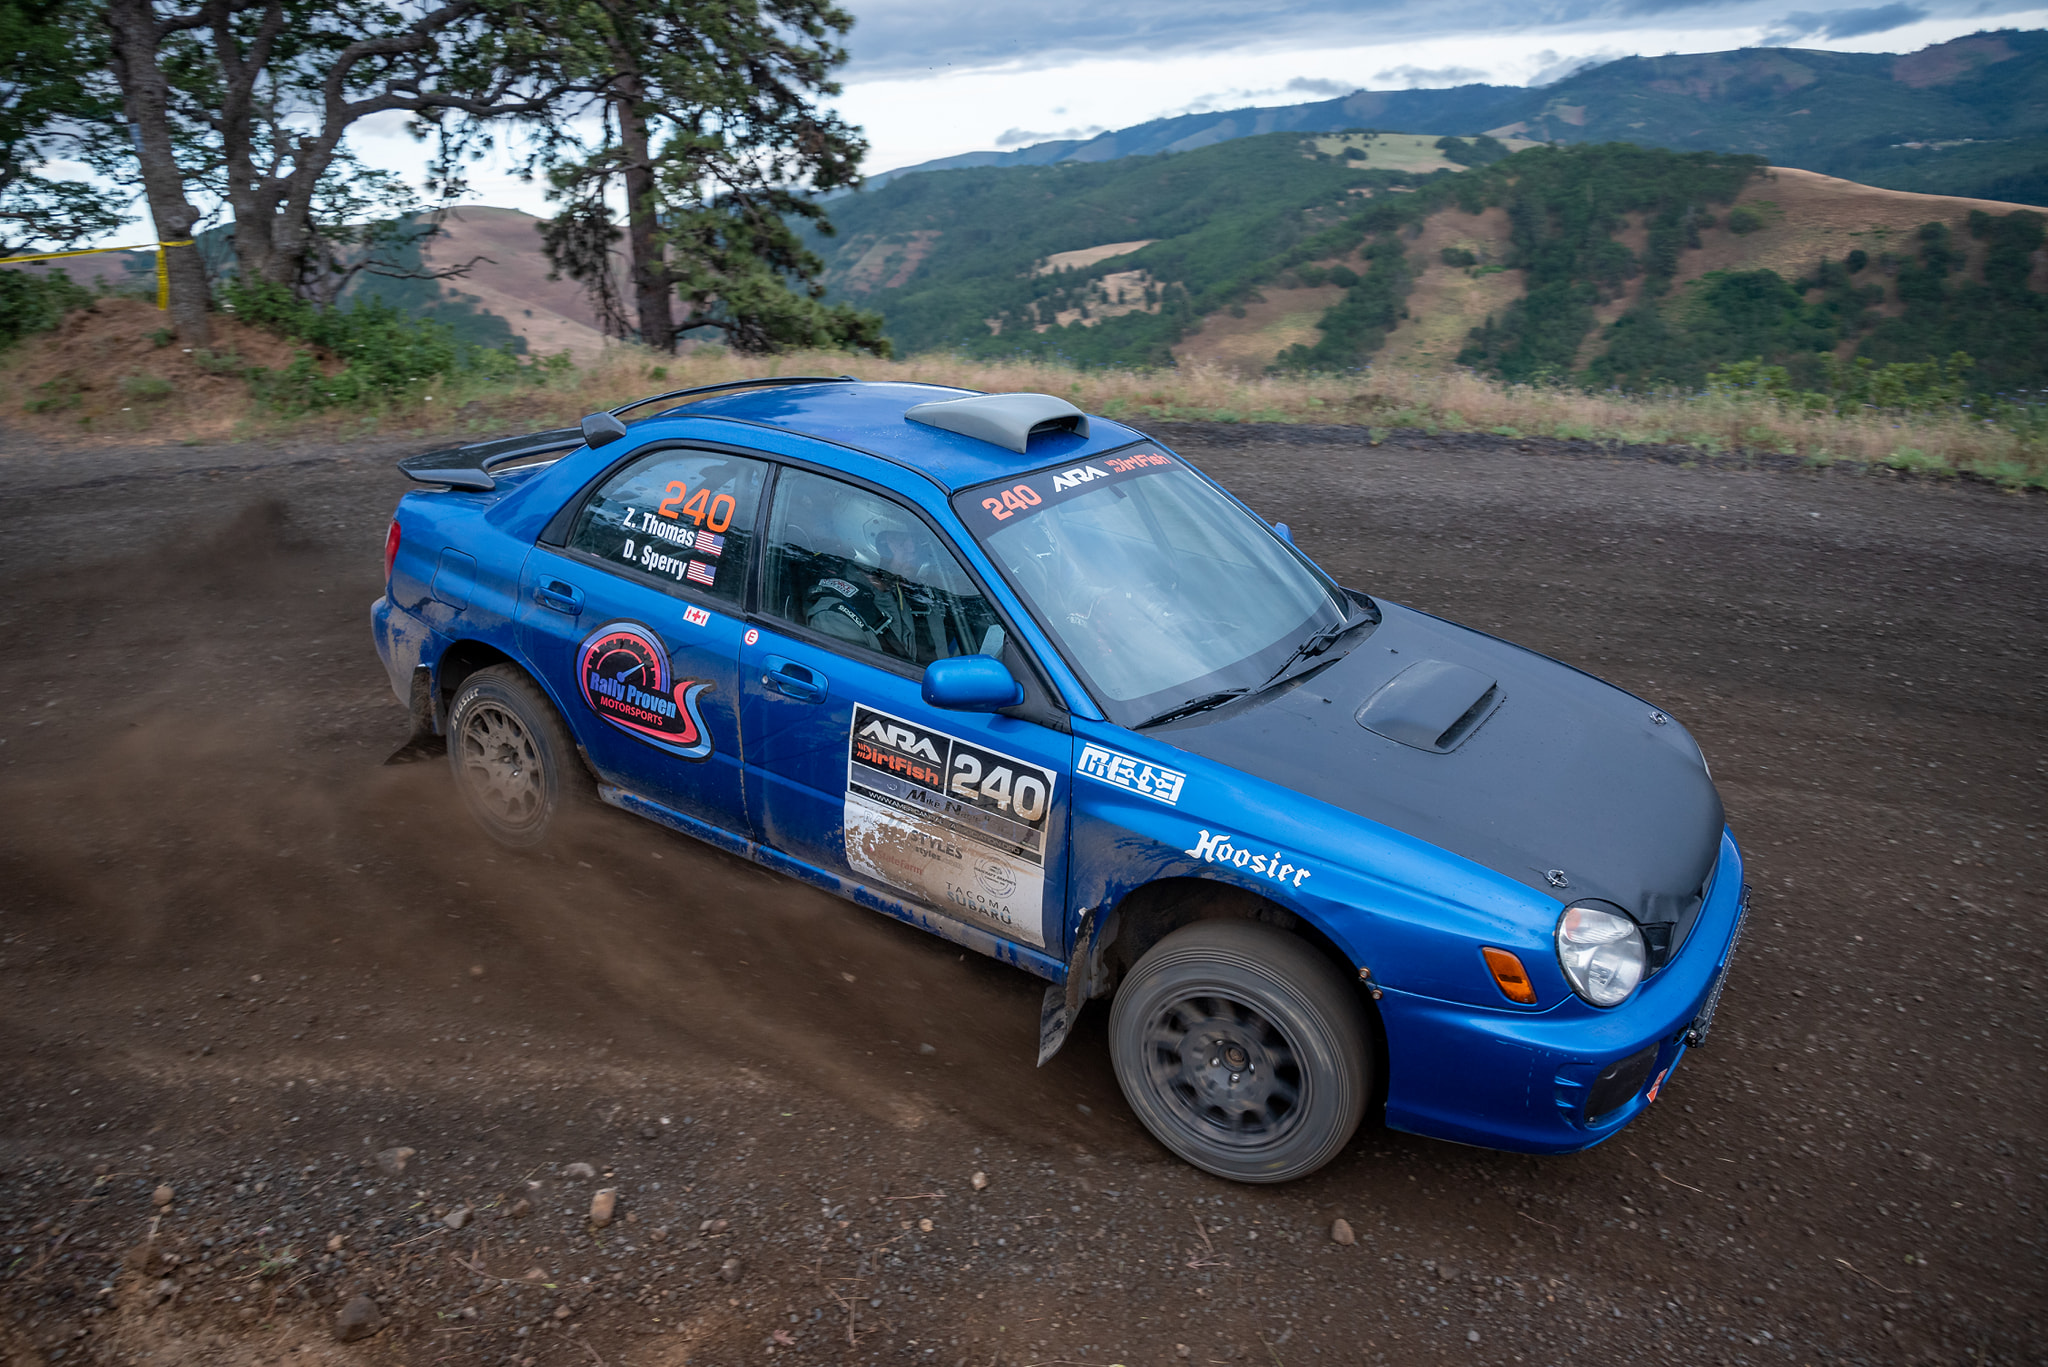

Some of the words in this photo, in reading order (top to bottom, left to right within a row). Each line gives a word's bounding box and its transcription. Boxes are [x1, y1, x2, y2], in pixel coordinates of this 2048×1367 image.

[658, 480, 736, 533] 240
[981, 484, 1042, 521] 240
[1052, 465, 1110, 493] ARA
[623, 507, 636, 528] Z.
[642, 512, 695, 547] Thomas
[623, 539, 637, 561] D.
[641, 545, 688, 581] Sperry
[589, 671, 626, 701] Rally
[627, 684, 677, 718] Proven
[600, 695, 663, 726] MOTORSPORTS
[859, 720, 942, 763] ARA
[857, 742, 939, 786] DirtFish
[951, 753, 1046, 822] 240
[910, 829, 963, 859] STYLES
[1184, 829, 1311, 888] Hoosier
[946, 881, 1011, 914] TACOMA
[947, 891, 1012, 924] SUBARU
